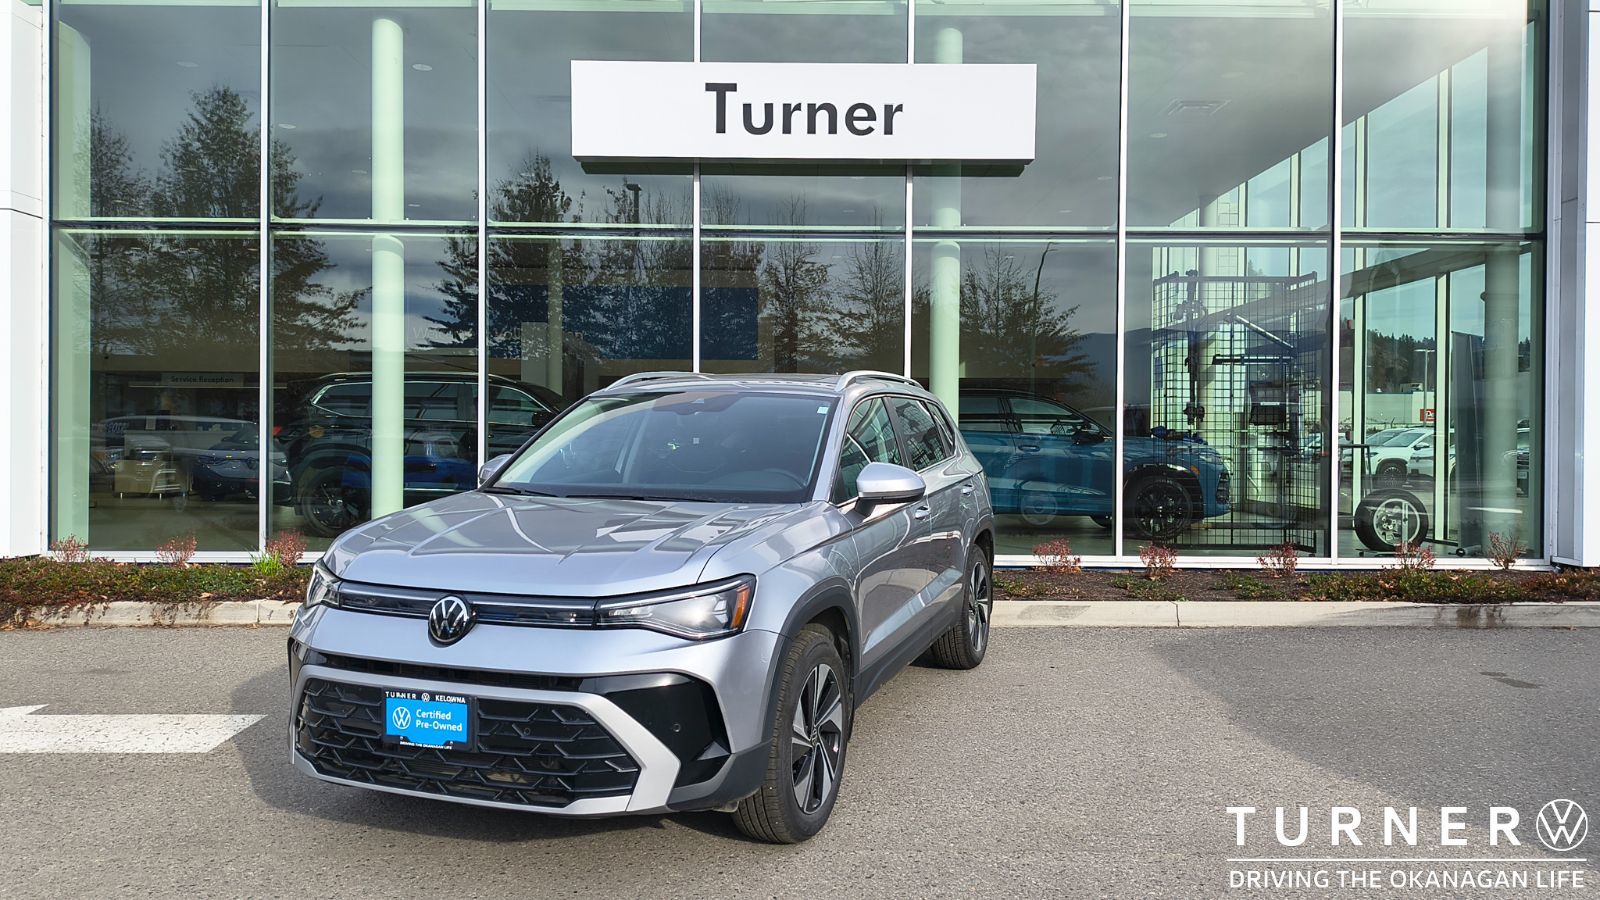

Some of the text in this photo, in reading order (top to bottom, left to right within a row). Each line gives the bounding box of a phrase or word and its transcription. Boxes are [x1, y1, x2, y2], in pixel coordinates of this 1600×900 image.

[705, 83, 903, 136] Turner
[385, 691, 417, 699] TURNER
[435, 694, 466, 703] KELOWNA
[416, 709, 451, 720] Certified
[416, 721, 462, 731] Pre-Owned
